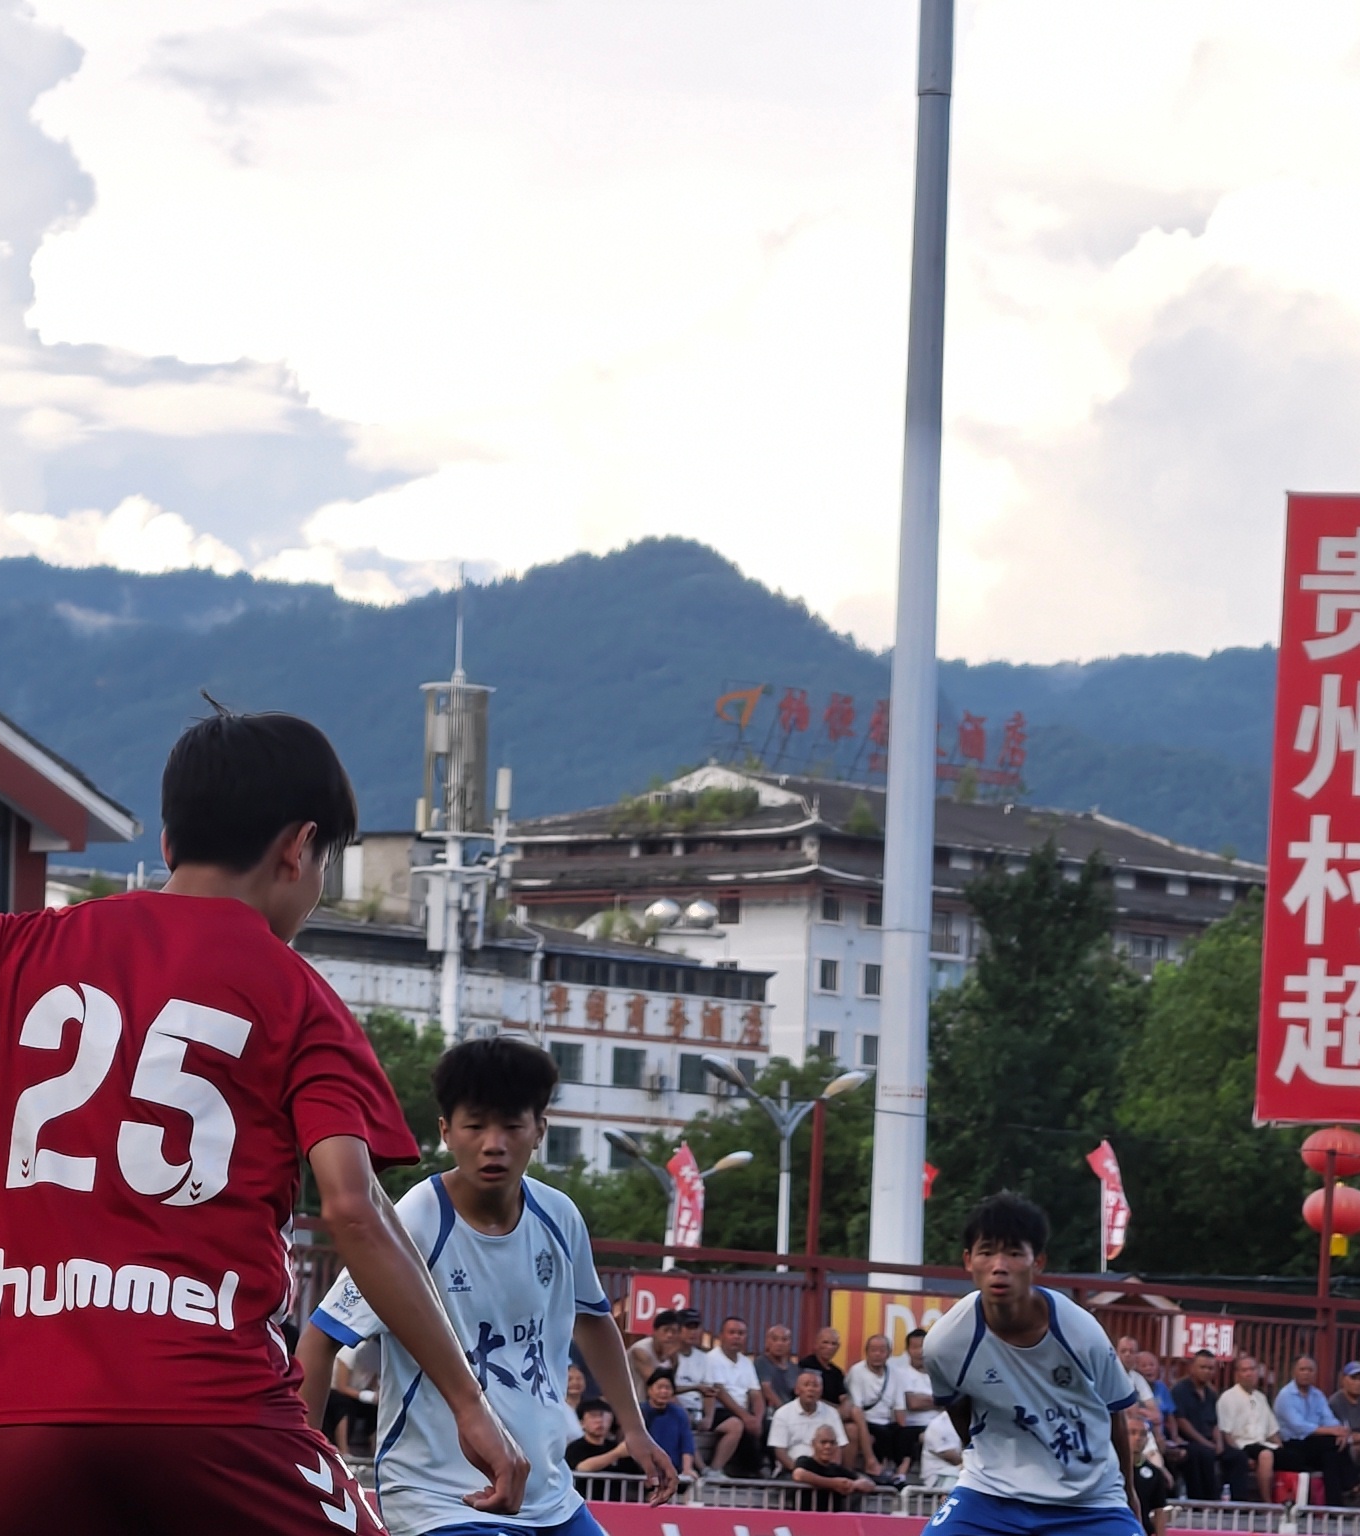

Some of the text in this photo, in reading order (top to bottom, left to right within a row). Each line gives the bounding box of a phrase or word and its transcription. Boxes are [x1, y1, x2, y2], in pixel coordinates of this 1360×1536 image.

[5, 982, 253, 1207] 25
[1188, 1321, 1235, 1357] 卫生间
